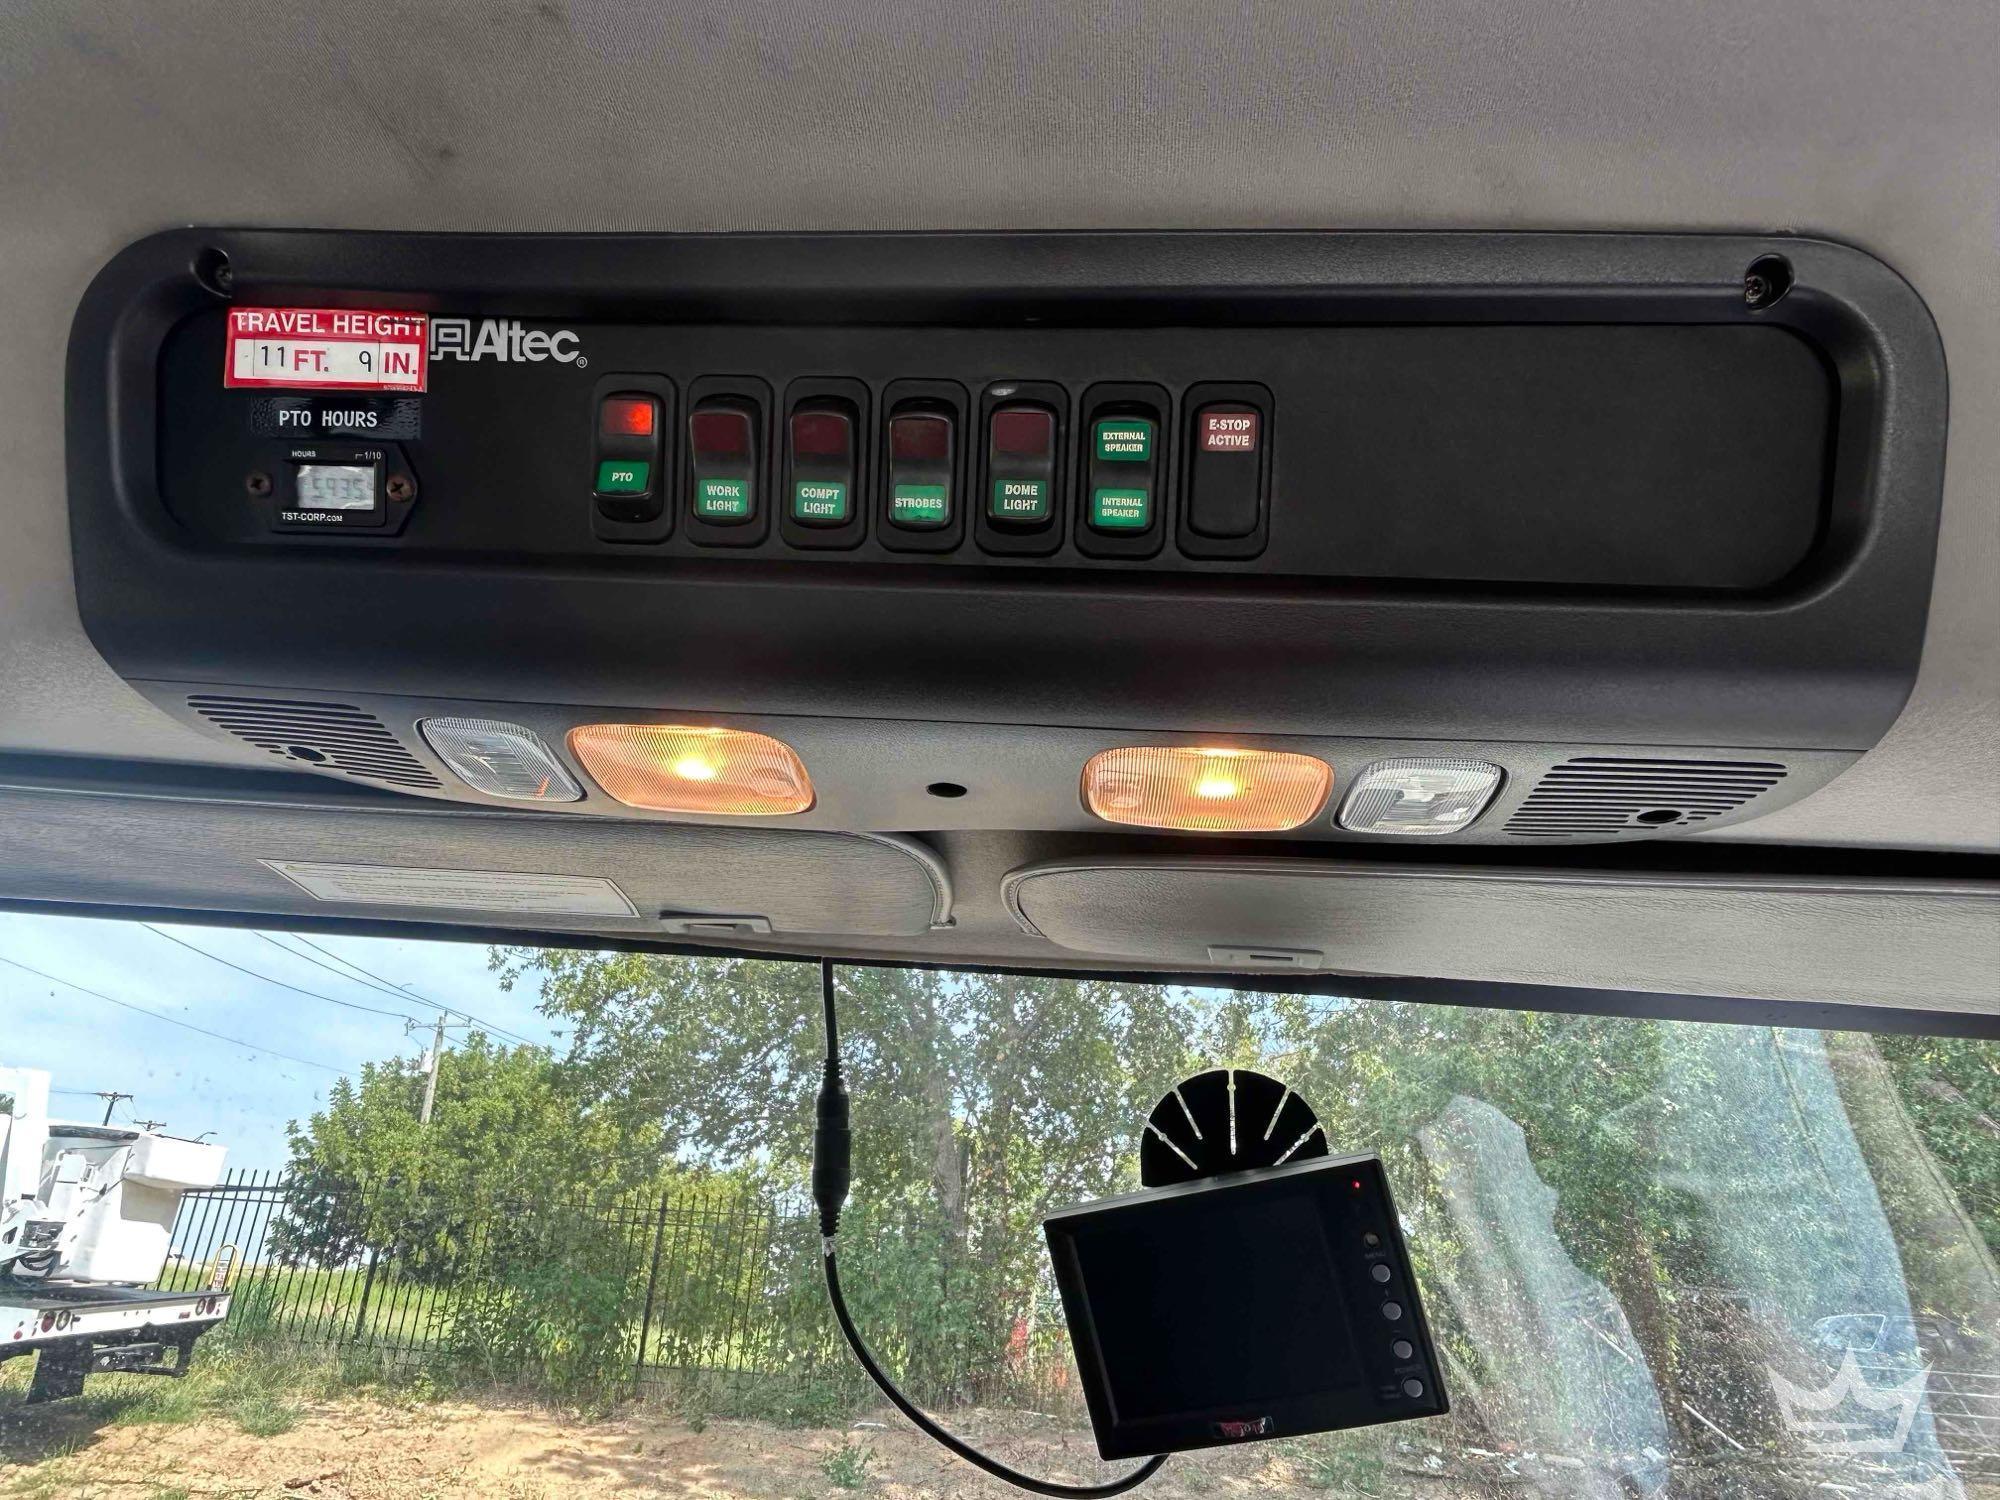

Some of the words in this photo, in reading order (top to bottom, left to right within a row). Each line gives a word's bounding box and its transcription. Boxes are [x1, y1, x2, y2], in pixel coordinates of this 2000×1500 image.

[233, 311, 326, 334] TRAVEL
[333, 313, 426, 337] HEIGHT
[470, 318, 581, 363] Altec
[261, 345, 285, 368] 11
[294, 349, 330, 373] FT.
[359, 350, 372, 373] 9
[384, 352, 418, 375] IN.
[278, 410, 312, 427] PTO
[322, 410, 378, 428] HOURS
[1103, 431, 1146, 441] EXTERNAL
[1208, 434, 1250, 446] ACTIVE
[1105, 443, 1143, 453] SPEAKER
[611, 472, 633, 482] PTO
[706, 485, 740, 498] WORK
[801, 487, 840, 500] COMPT
[1004, 484, 1038, 497] DOME
[706, 499, 740, 512] LIGHT
[803, 502, 836, 515] LIGHT
[895, 497, 943, 509] STROBES
[1003, 499, 1038, 512] LIGHT
[1102, 497, 1143, 507] INTERNAL
[1101, 508, 1140, 518] SPEAKER
